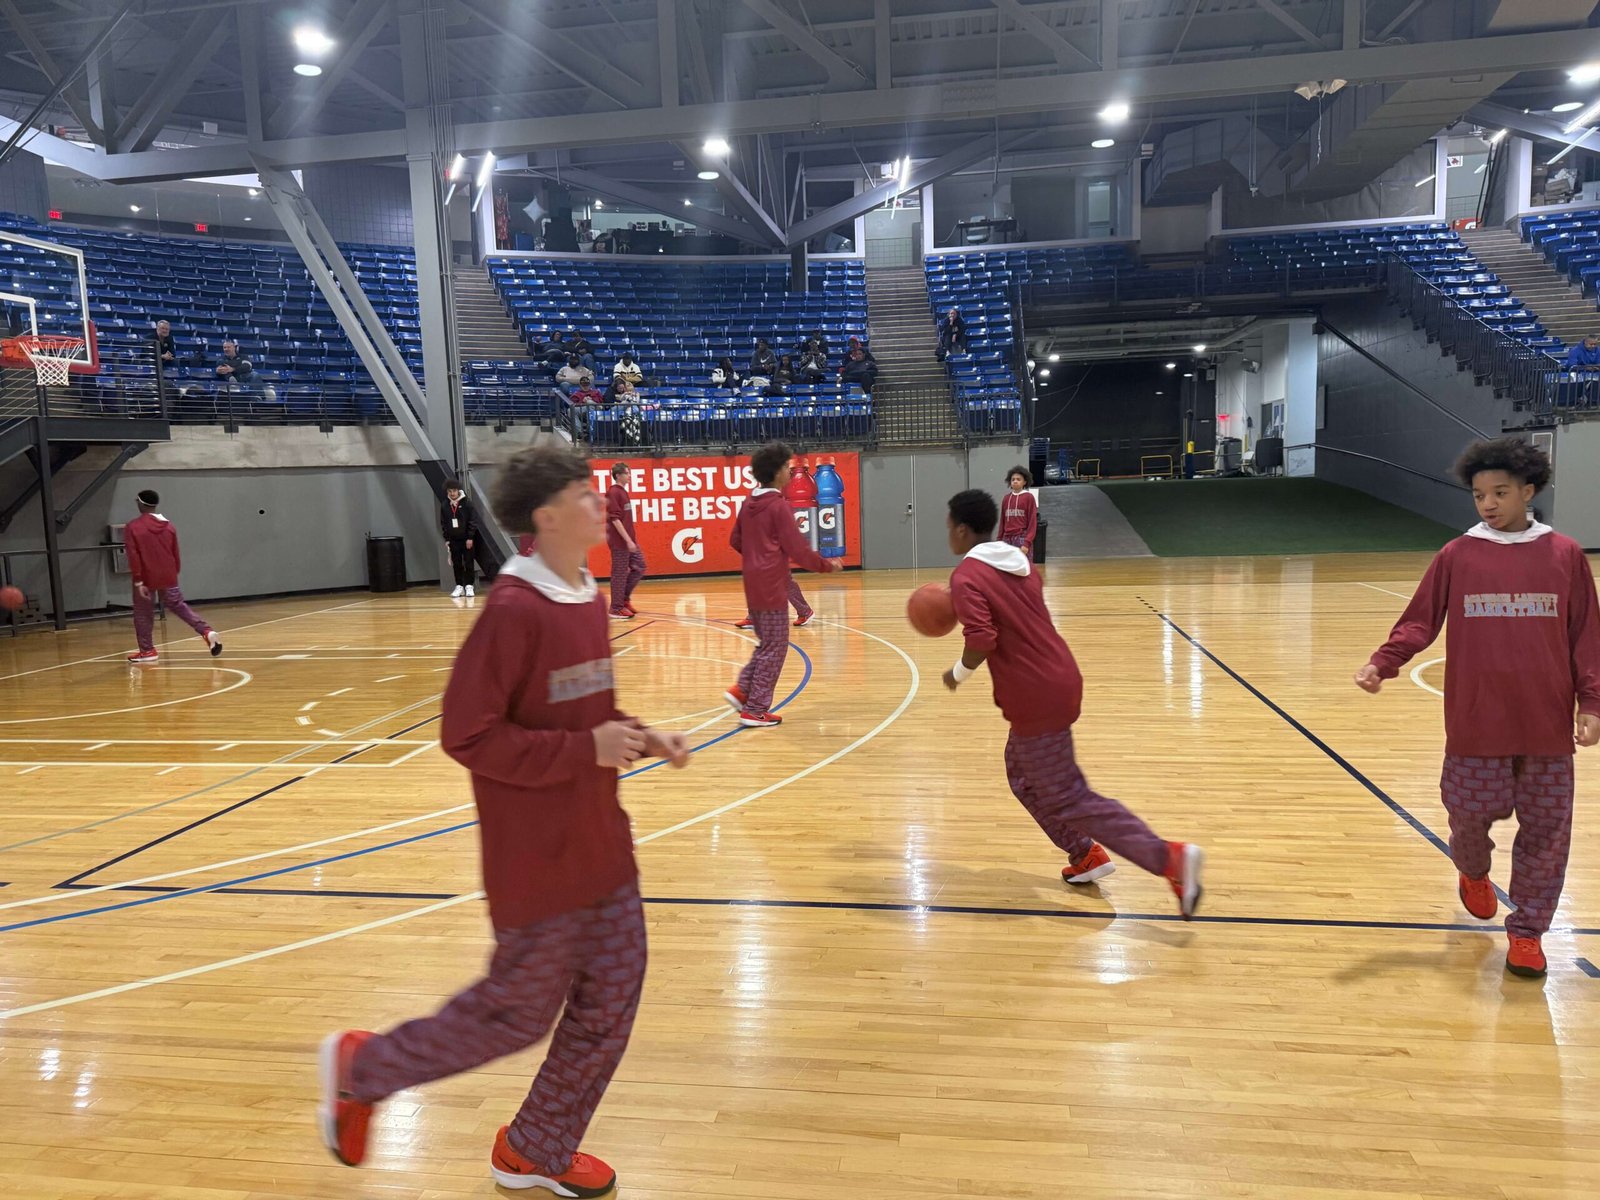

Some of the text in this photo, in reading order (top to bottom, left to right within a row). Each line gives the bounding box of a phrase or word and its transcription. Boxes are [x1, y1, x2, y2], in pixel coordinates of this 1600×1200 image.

[593, 465, 762, 494] TE BEST US
[630, 495, 747, 523] THE BEST
[818, 507, 836, 530] G
[671, 527, 704, 564] G
